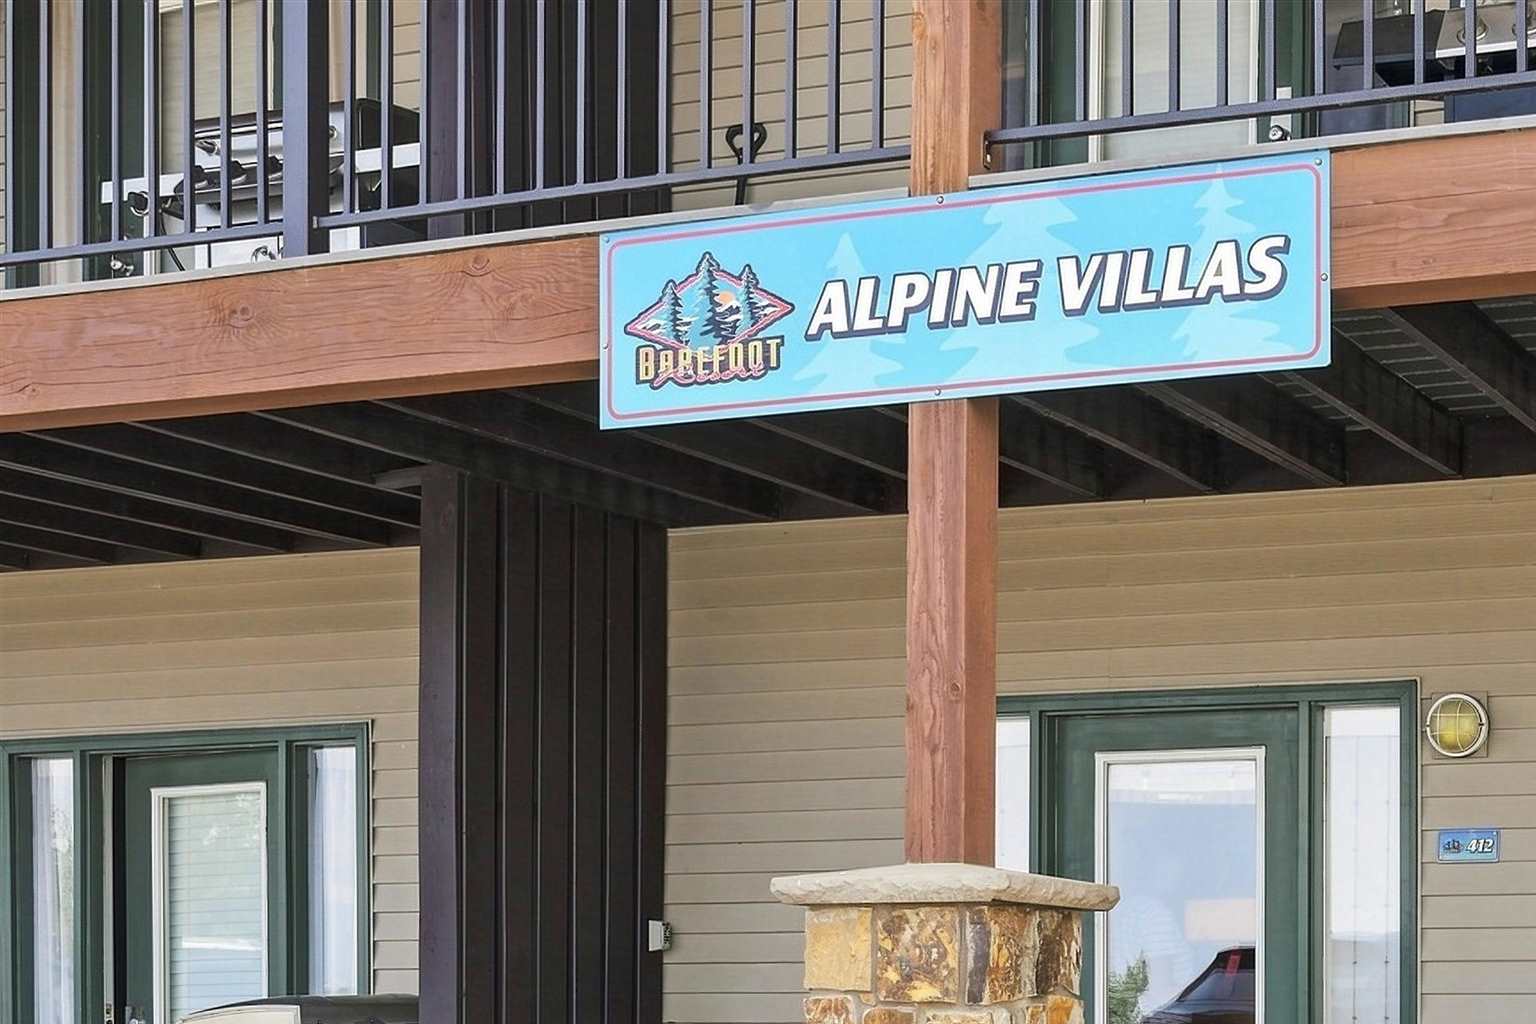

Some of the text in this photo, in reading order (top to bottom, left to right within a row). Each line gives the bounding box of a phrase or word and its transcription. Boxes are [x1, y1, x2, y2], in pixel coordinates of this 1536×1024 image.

[804, 235, 1290, 342] ALPINE VILLAS
[1466, 838, 1494, 853] 412
